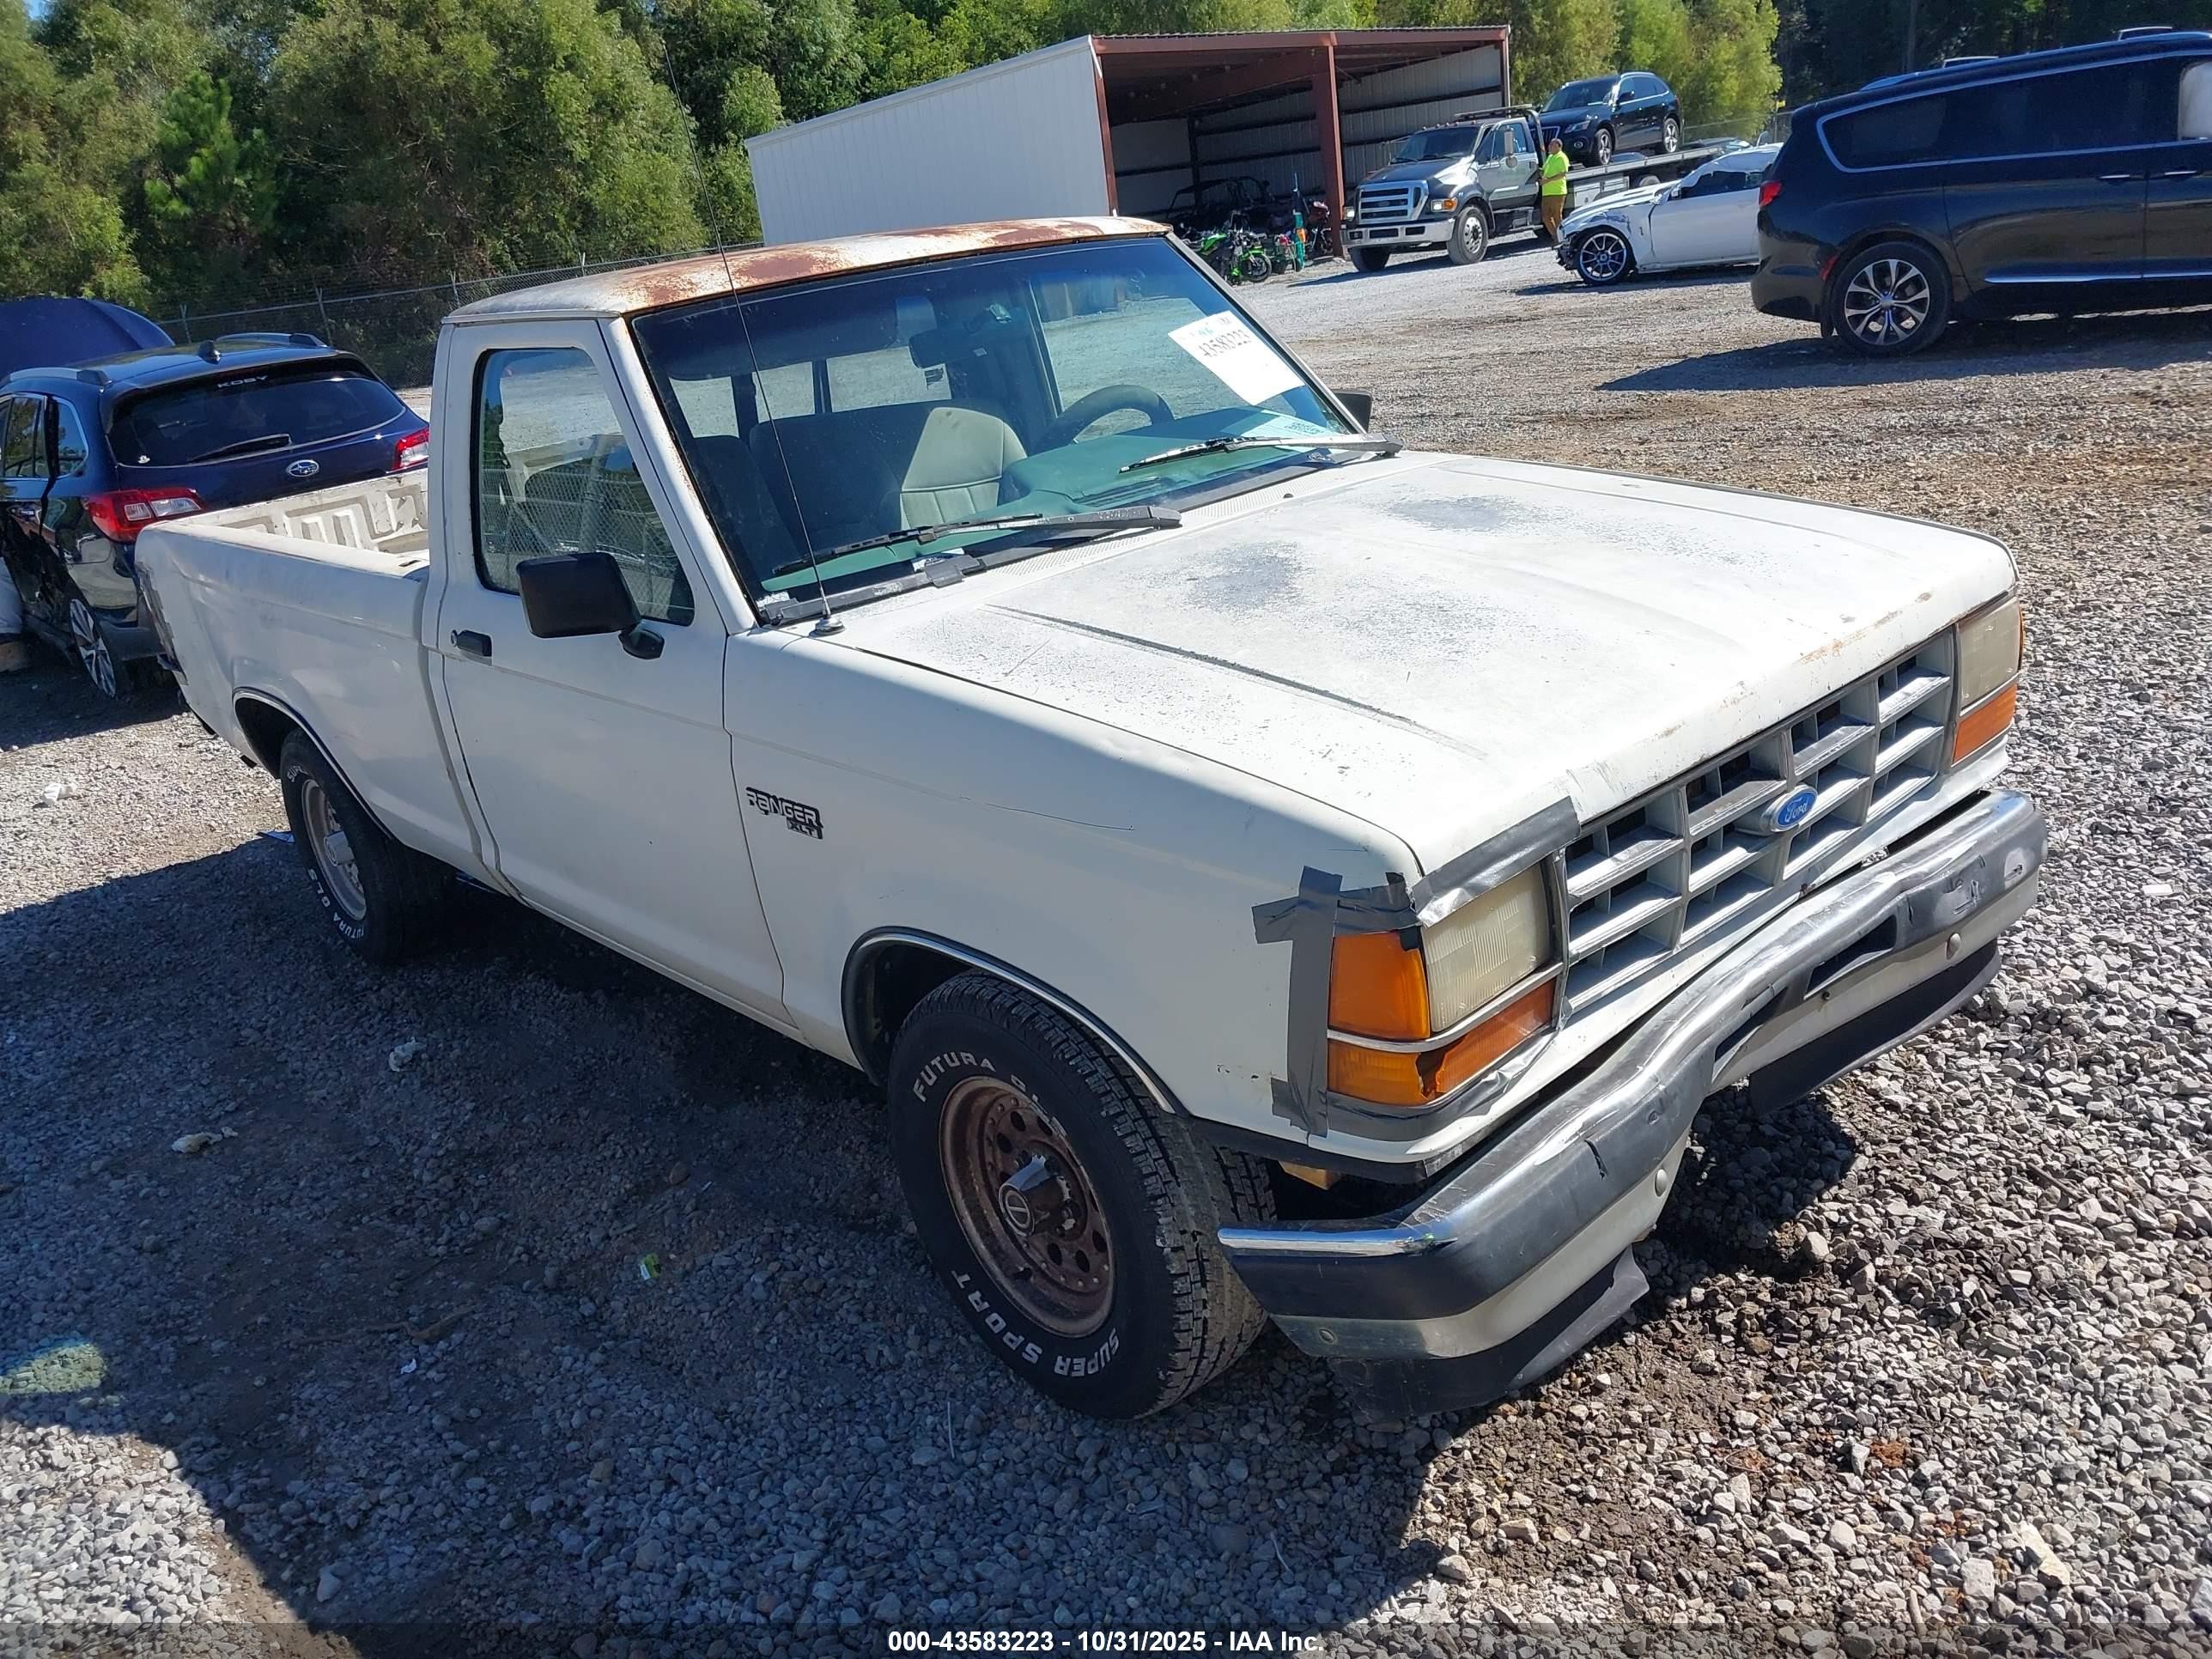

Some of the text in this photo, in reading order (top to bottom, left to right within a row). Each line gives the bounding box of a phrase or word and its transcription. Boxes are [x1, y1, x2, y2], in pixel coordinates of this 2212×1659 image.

[745, 787, 823, 829] RANGER
[1784, 795, 1810, 823] Ford
[787, 821, 823, 840] XLT
[913, 1051, 996, 1103] FUTURA
[951, 1270, 1120, 1376] SUPER SPORT
